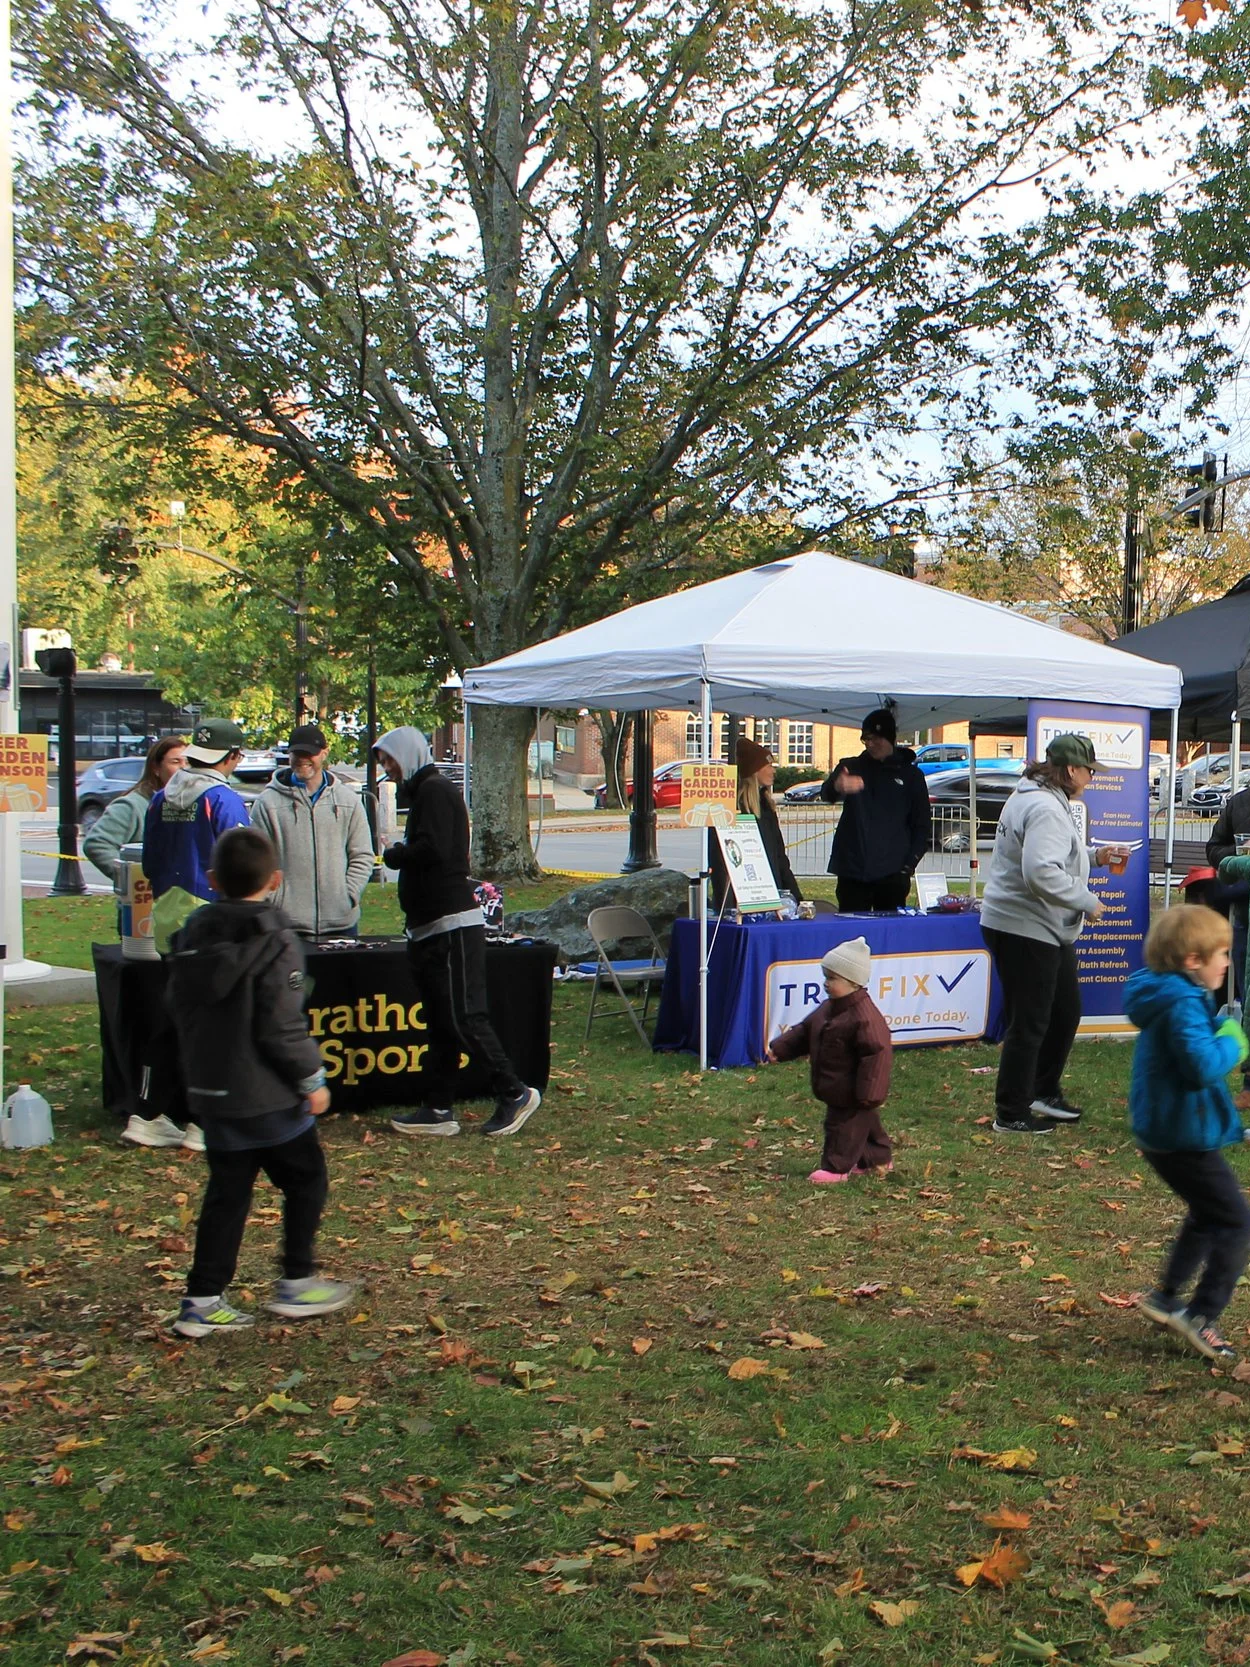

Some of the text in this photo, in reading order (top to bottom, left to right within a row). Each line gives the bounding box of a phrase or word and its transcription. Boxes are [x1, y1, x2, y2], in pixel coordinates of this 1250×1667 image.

[1088, 731, 1114, 744] FIX
[693, 767, 725, 777] BEER
[683, 778, 736, 789] GARDEN
[1095, 783, 1122, 792] Services
[683, 789, 736, 799] SPONSOR
[1089, 877, 1109, 886] epair
[1100, 890, 1126, 899] Repair
[1093, 933, 1143, 942] Replacement
[1088, 947, 1126, 956] Assembly
[1100, 960, 1128, 969] Refresh
[1095, 975, 1118, 983] Clean
[779, 974, 931, 1007] TR FIX
[885, 1010, 970, 1027] Done Today.
[318, 1039, 470, 1086] Spor
